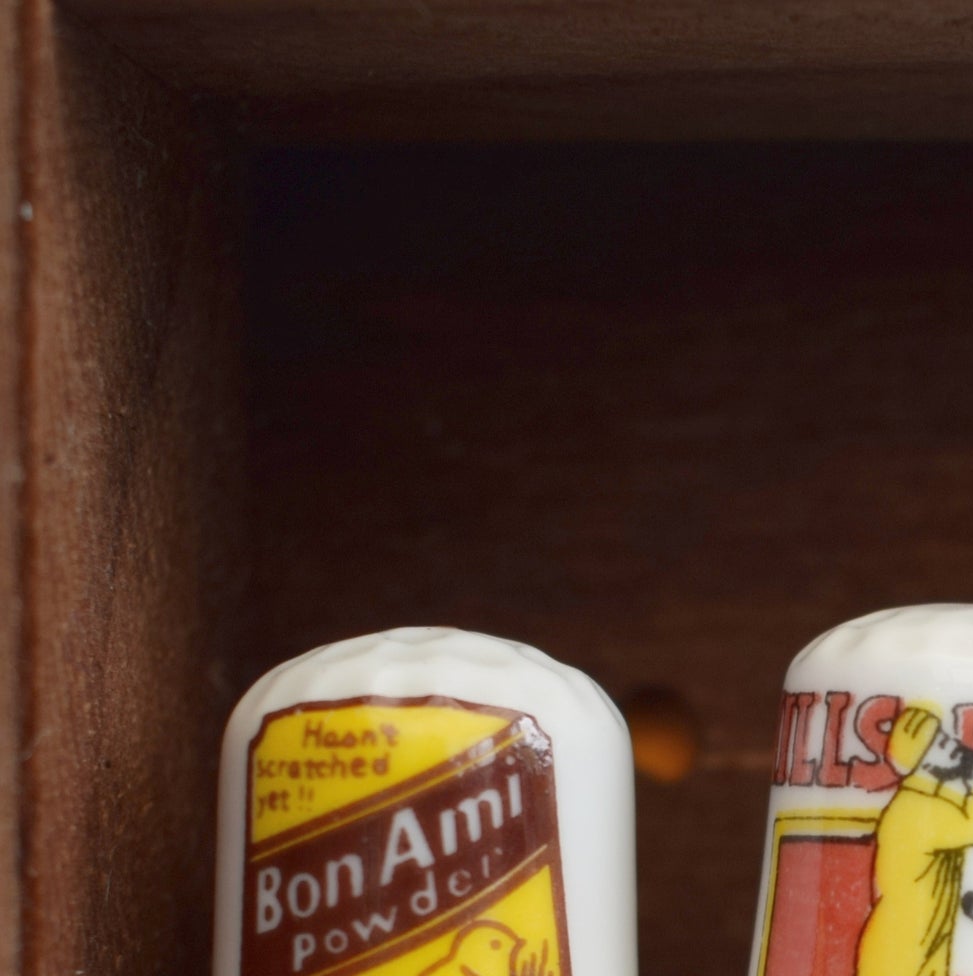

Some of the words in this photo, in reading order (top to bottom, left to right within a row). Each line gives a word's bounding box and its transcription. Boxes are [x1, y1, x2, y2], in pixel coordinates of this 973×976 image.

[256, 752, 390, 780] scratched
[771, 690, 906, 793] ILLS
[256, 853, 364, 935] Bon
[379, 754, 523, 887] Ami
